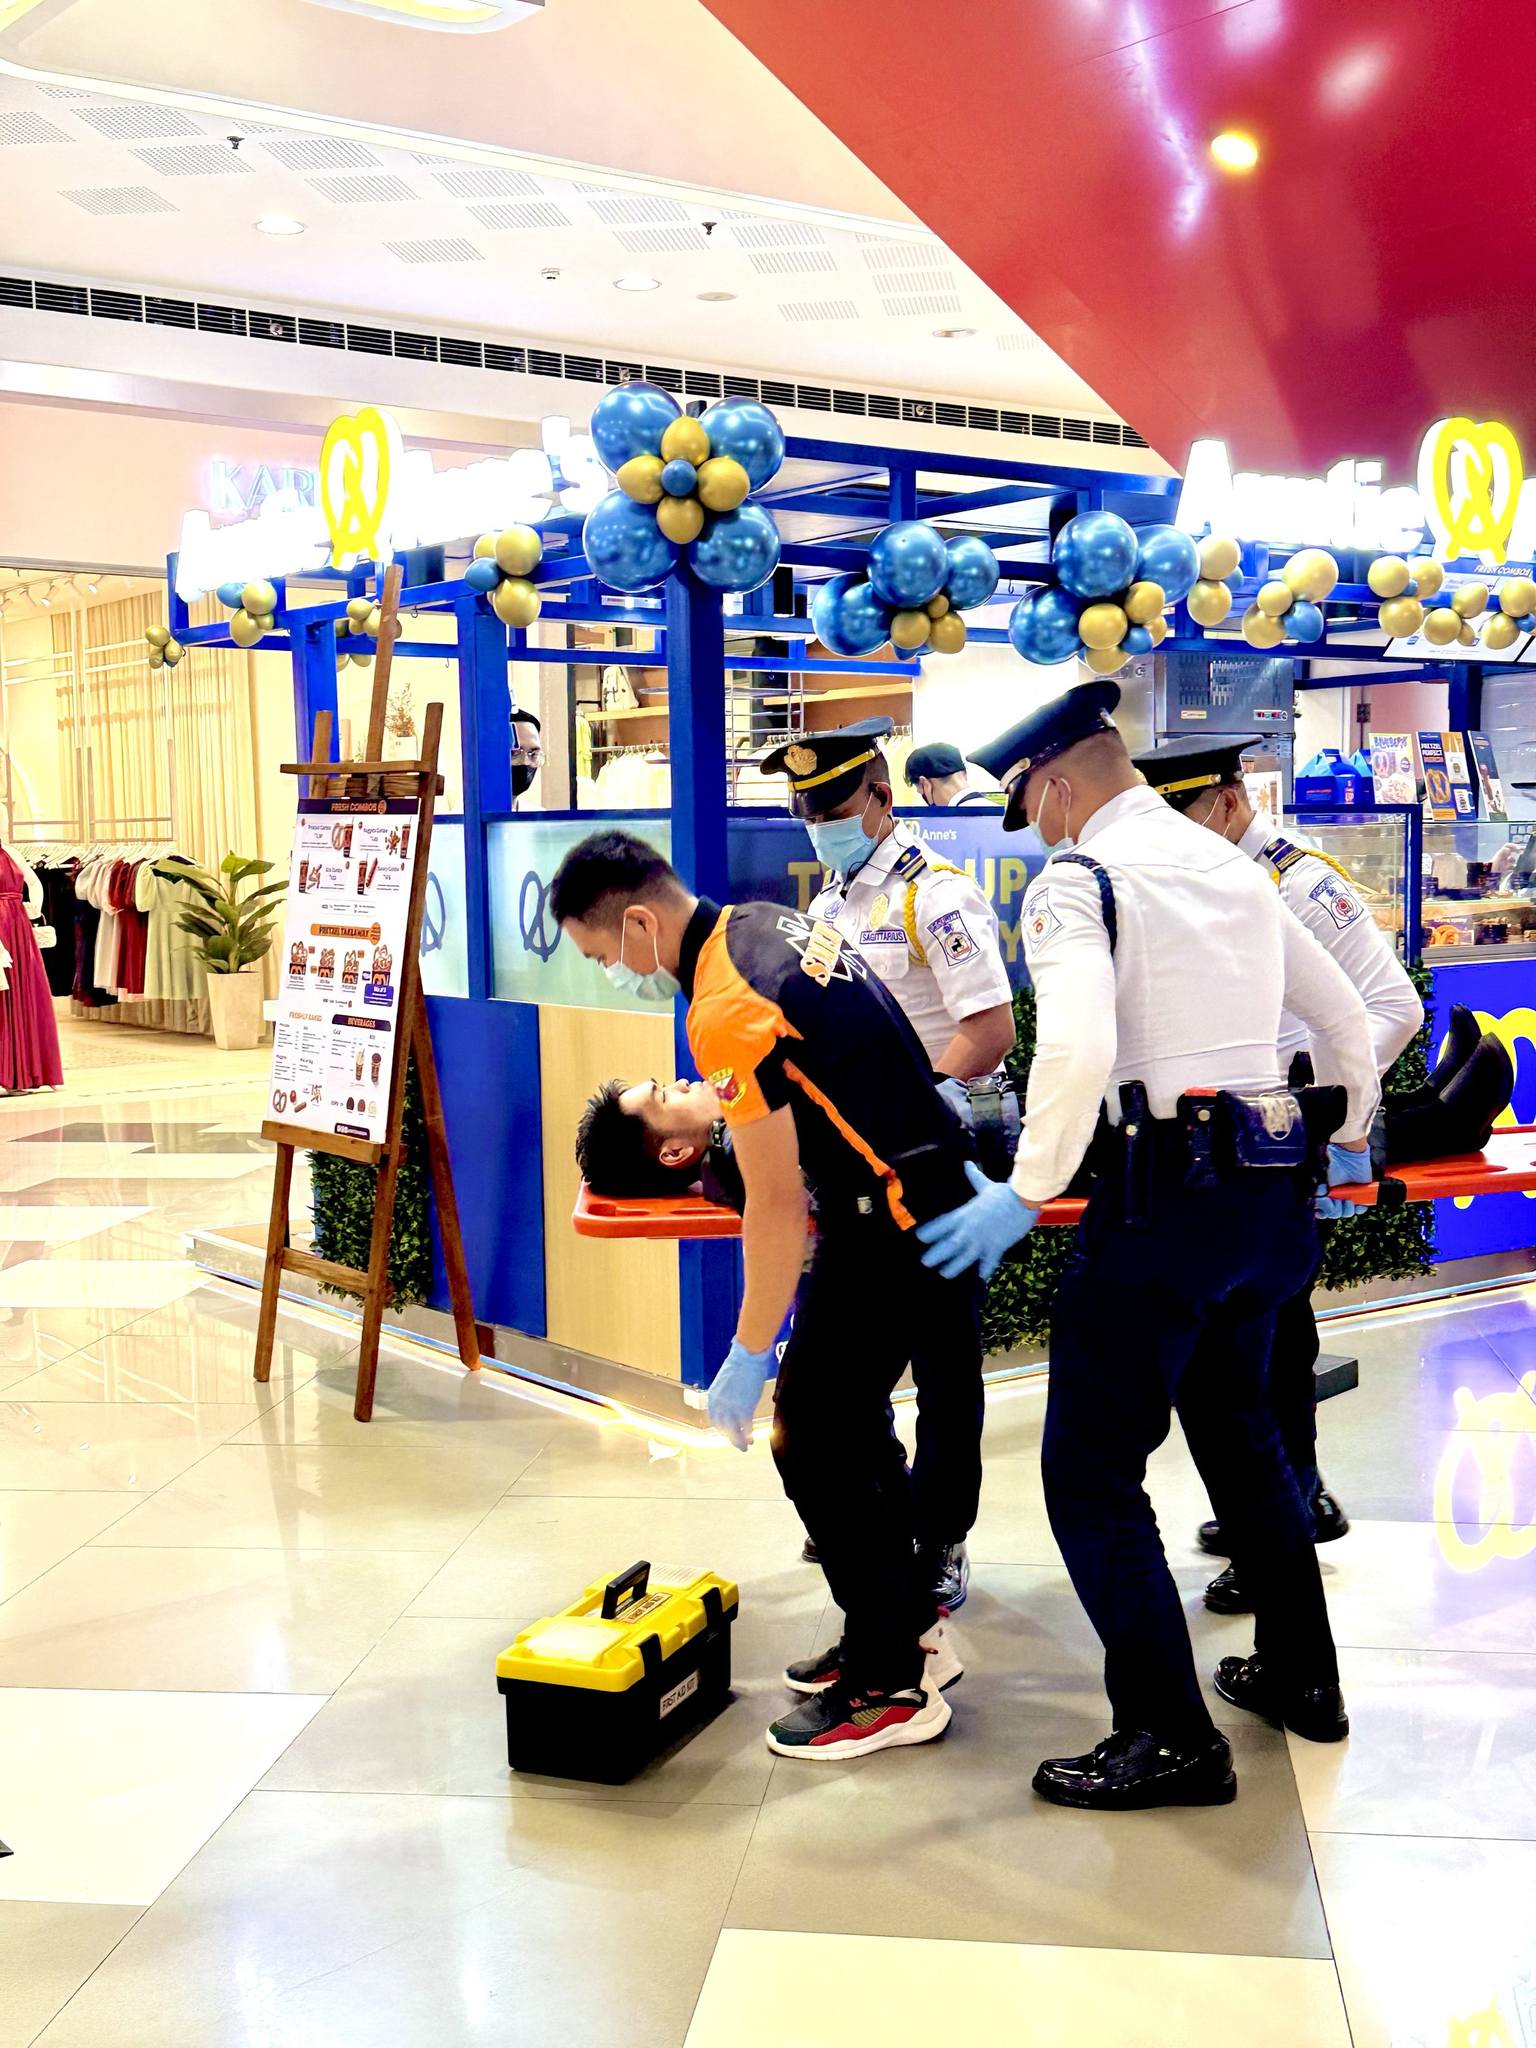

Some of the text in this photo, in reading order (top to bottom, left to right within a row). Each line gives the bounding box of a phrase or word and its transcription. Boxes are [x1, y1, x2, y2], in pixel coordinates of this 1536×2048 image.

[350, 802, 378, 812] COMBOS
[921, 829, 957, 841] Anne's
[862, 931, 905, 943] SAGITTARIUS
[347, 1017, 376, 1028] BEVERAGES
[662, 1691, 677, 1712] FIRST
